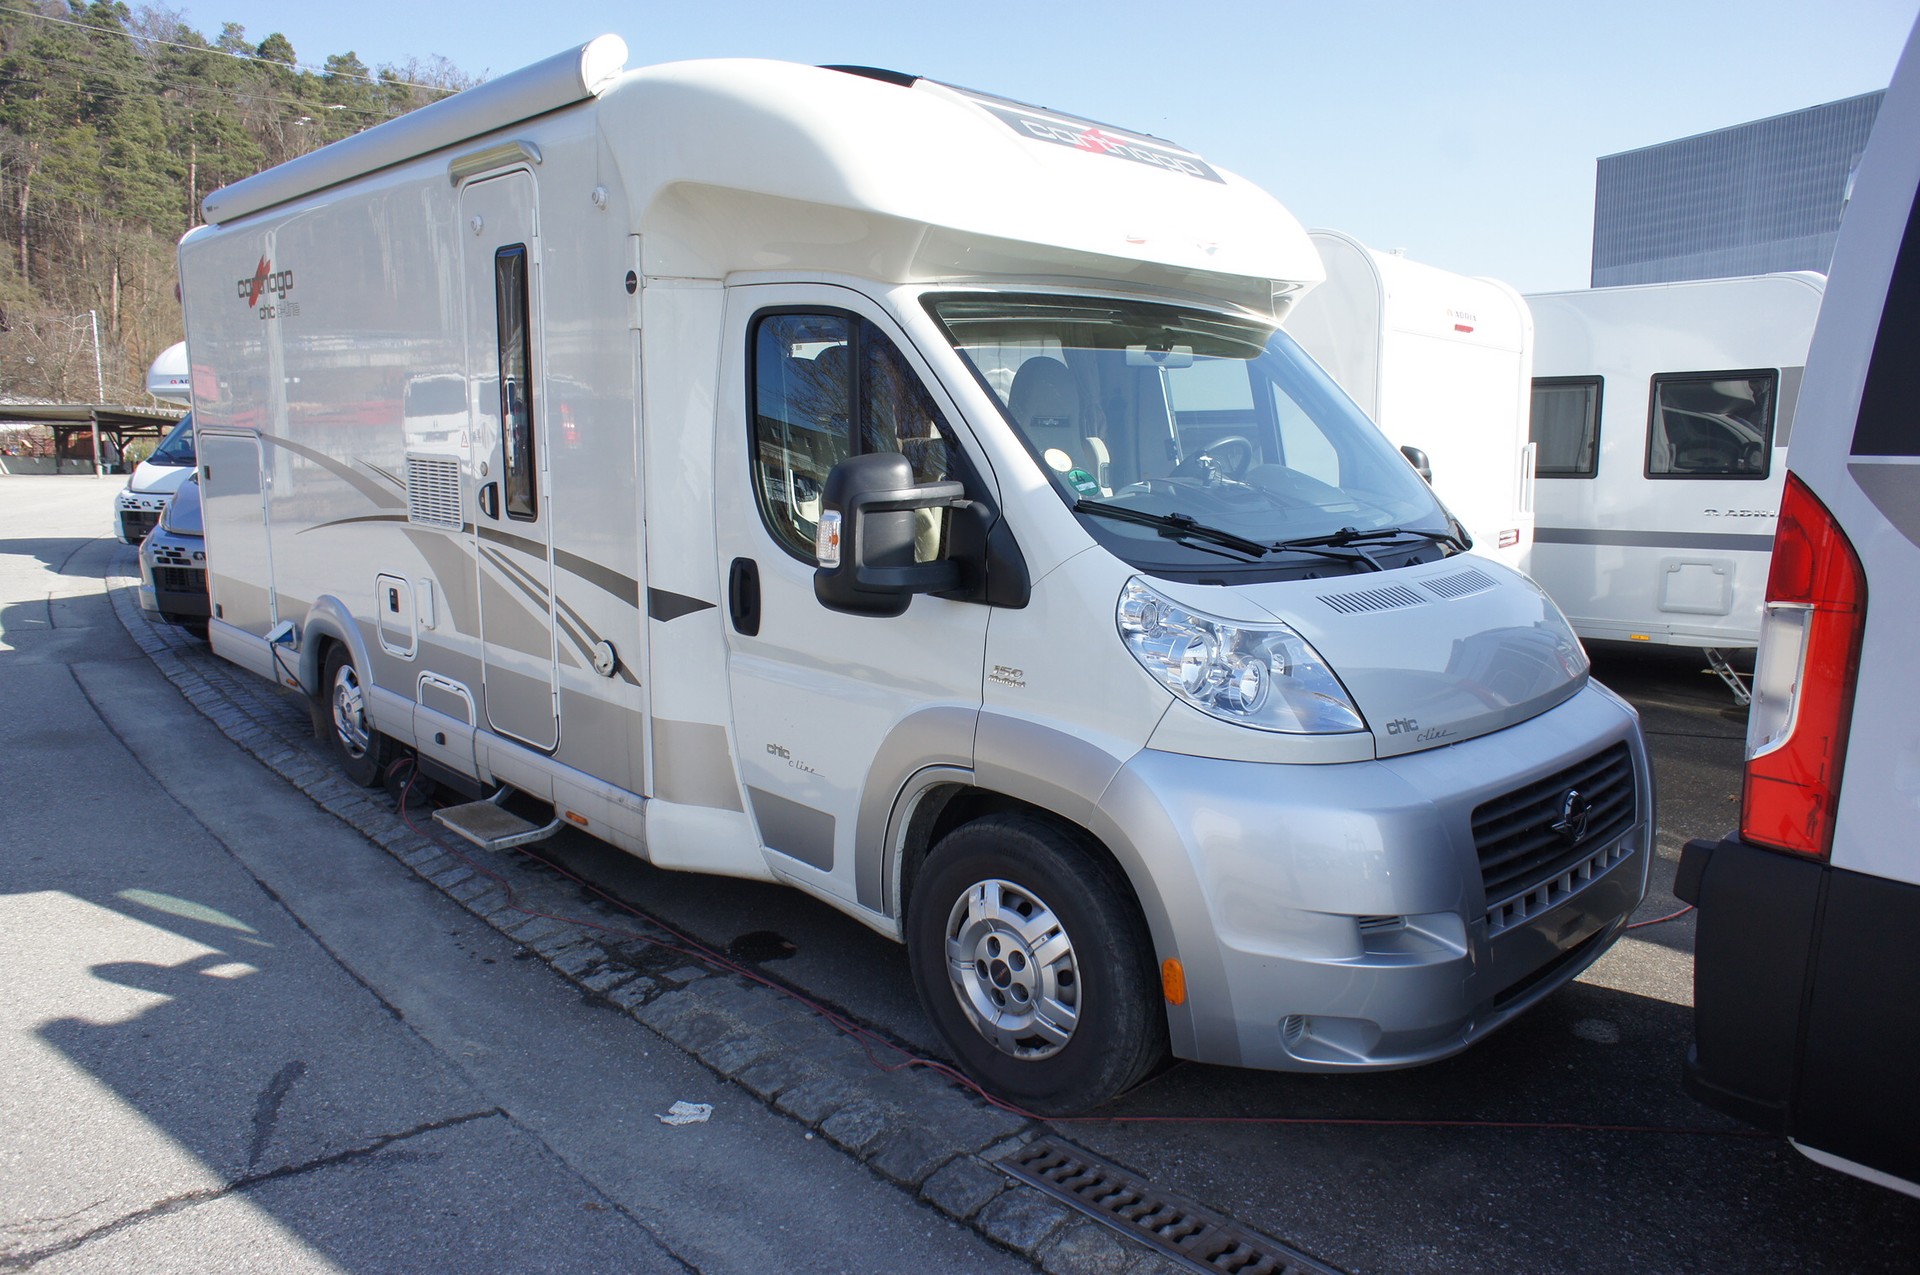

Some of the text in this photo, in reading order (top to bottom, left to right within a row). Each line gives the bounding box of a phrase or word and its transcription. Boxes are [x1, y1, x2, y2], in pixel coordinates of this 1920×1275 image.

[993, 664, 1023, 678] 150
[1386, 718, 1419, 735] chic
[766, 743, 791, 760] chic
